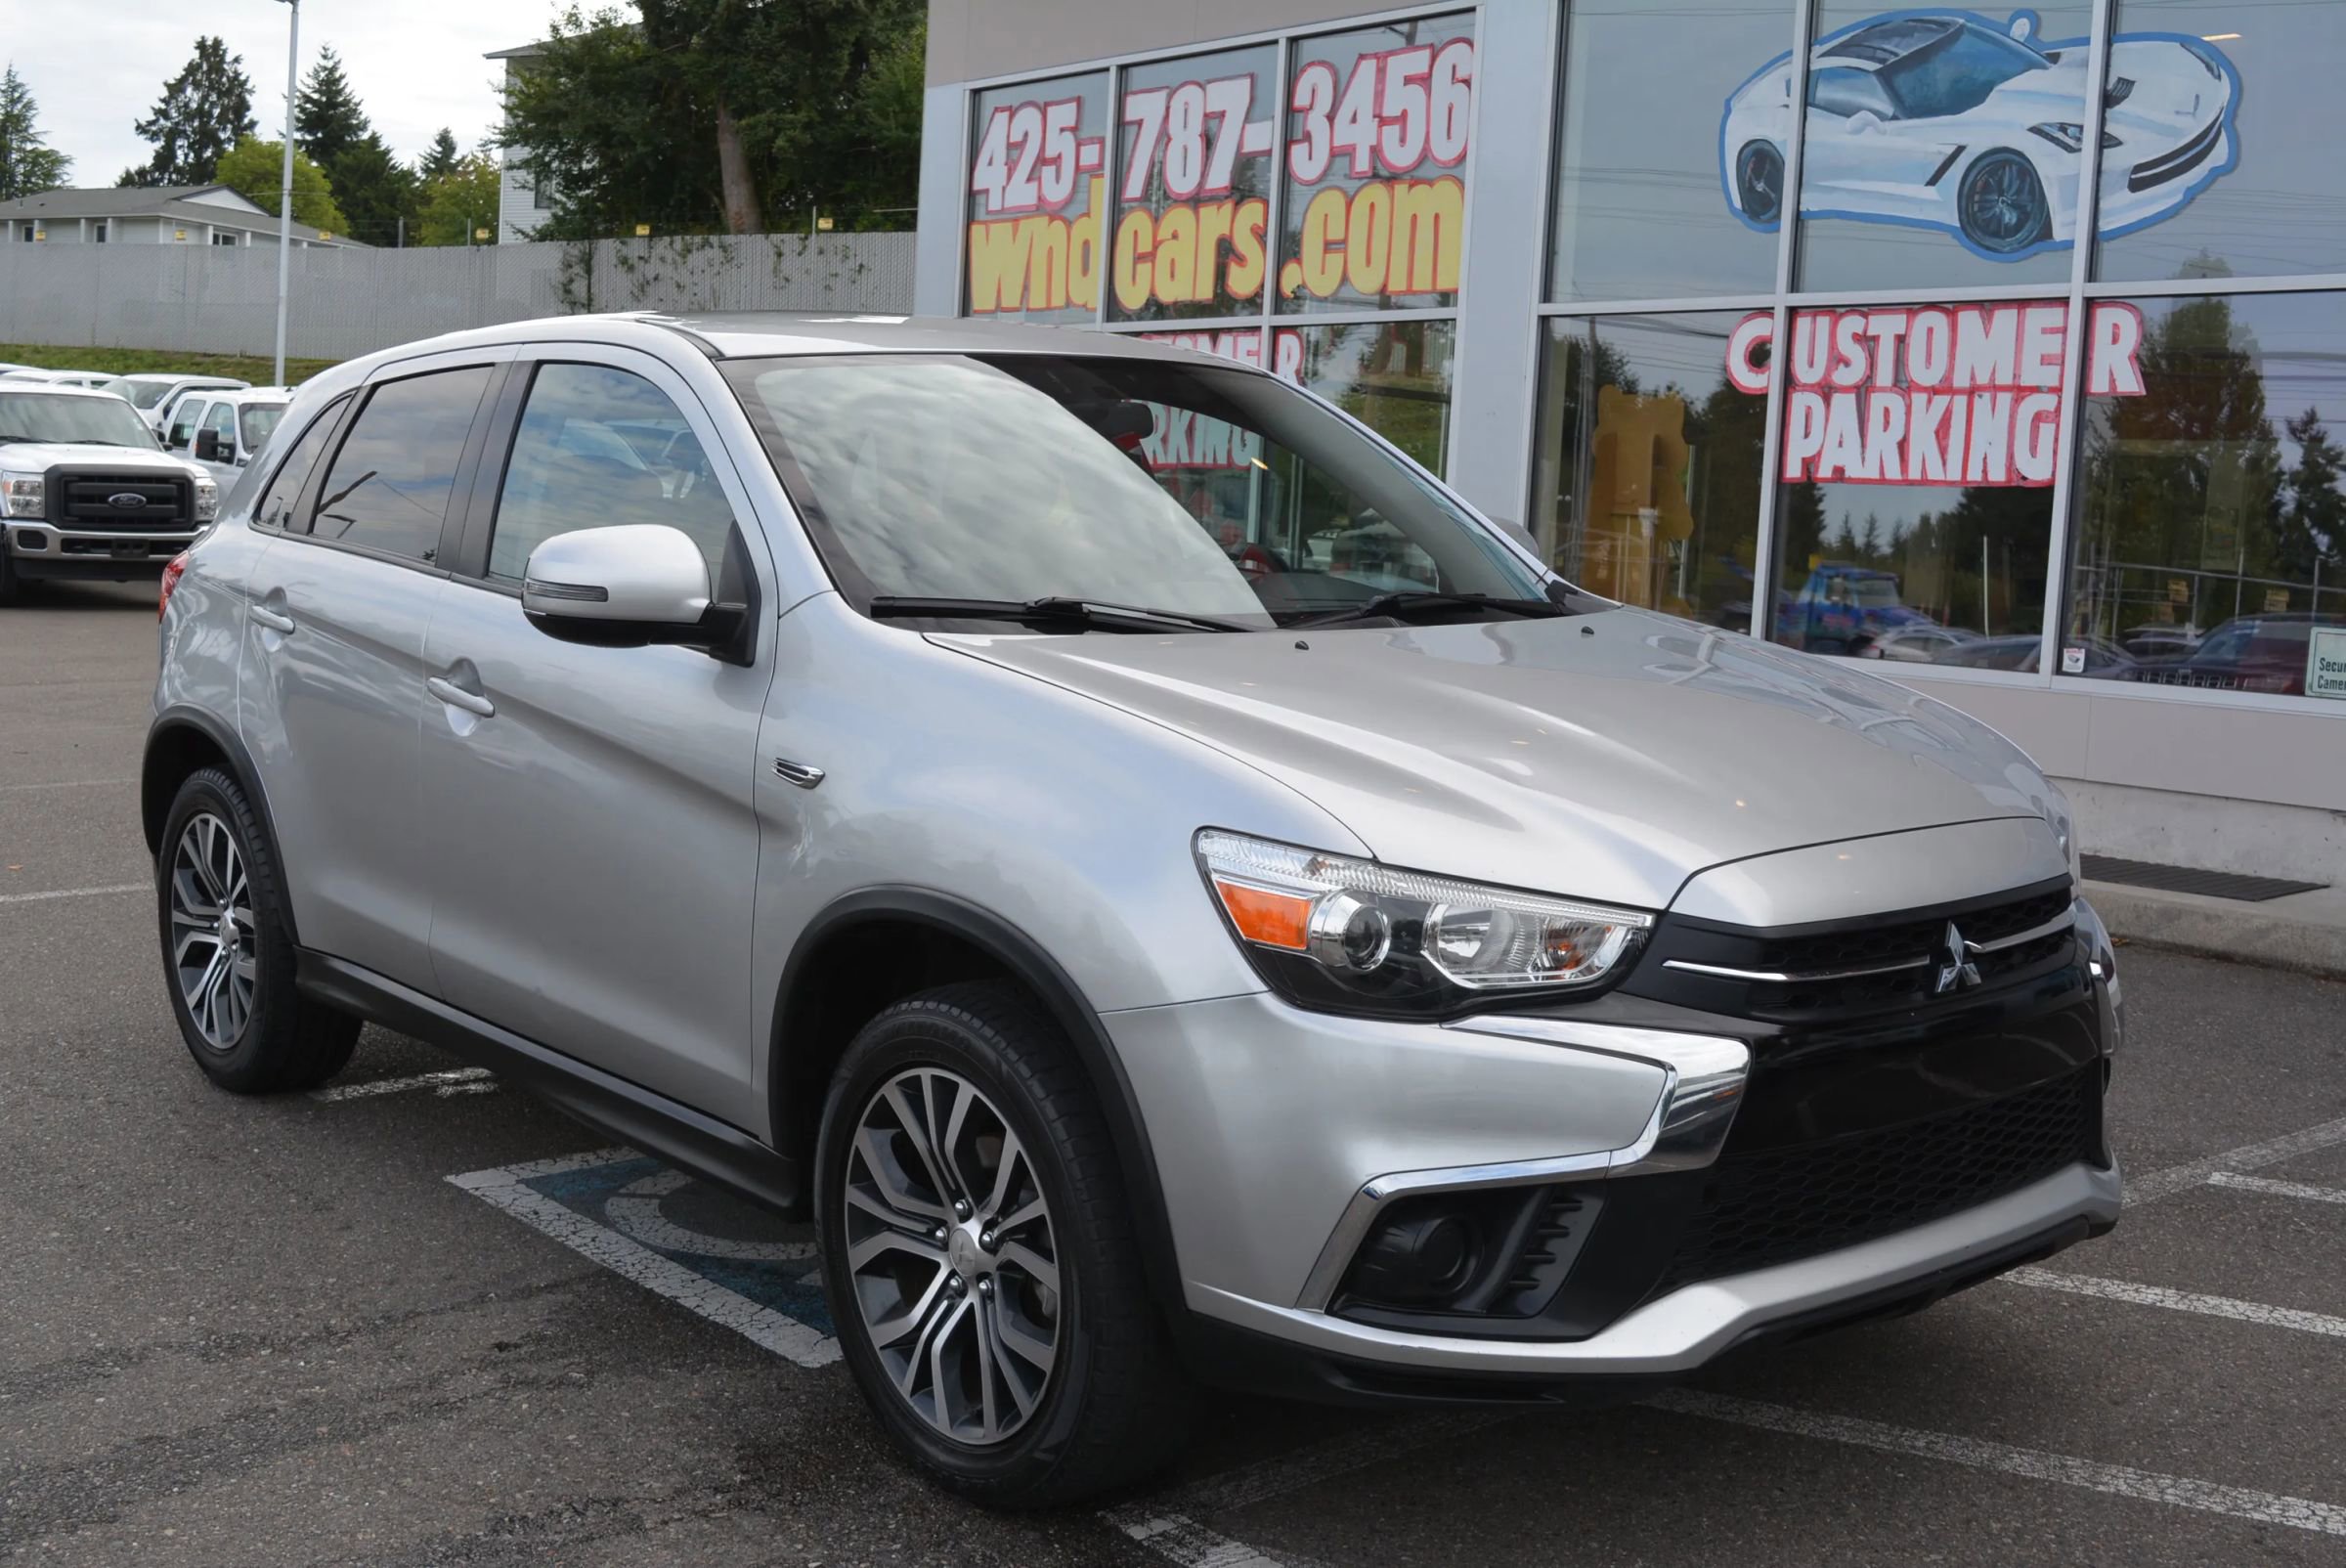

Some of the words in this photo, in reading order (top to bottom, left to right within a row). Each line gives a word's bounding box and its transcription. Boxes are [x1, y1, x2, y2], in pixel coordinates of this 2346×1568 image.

[1726, 300, 2146, 396] CUSTOMER
[1138, 401, 1259, 470] RKING
[1782, 386, 2060, 487] PARKING
